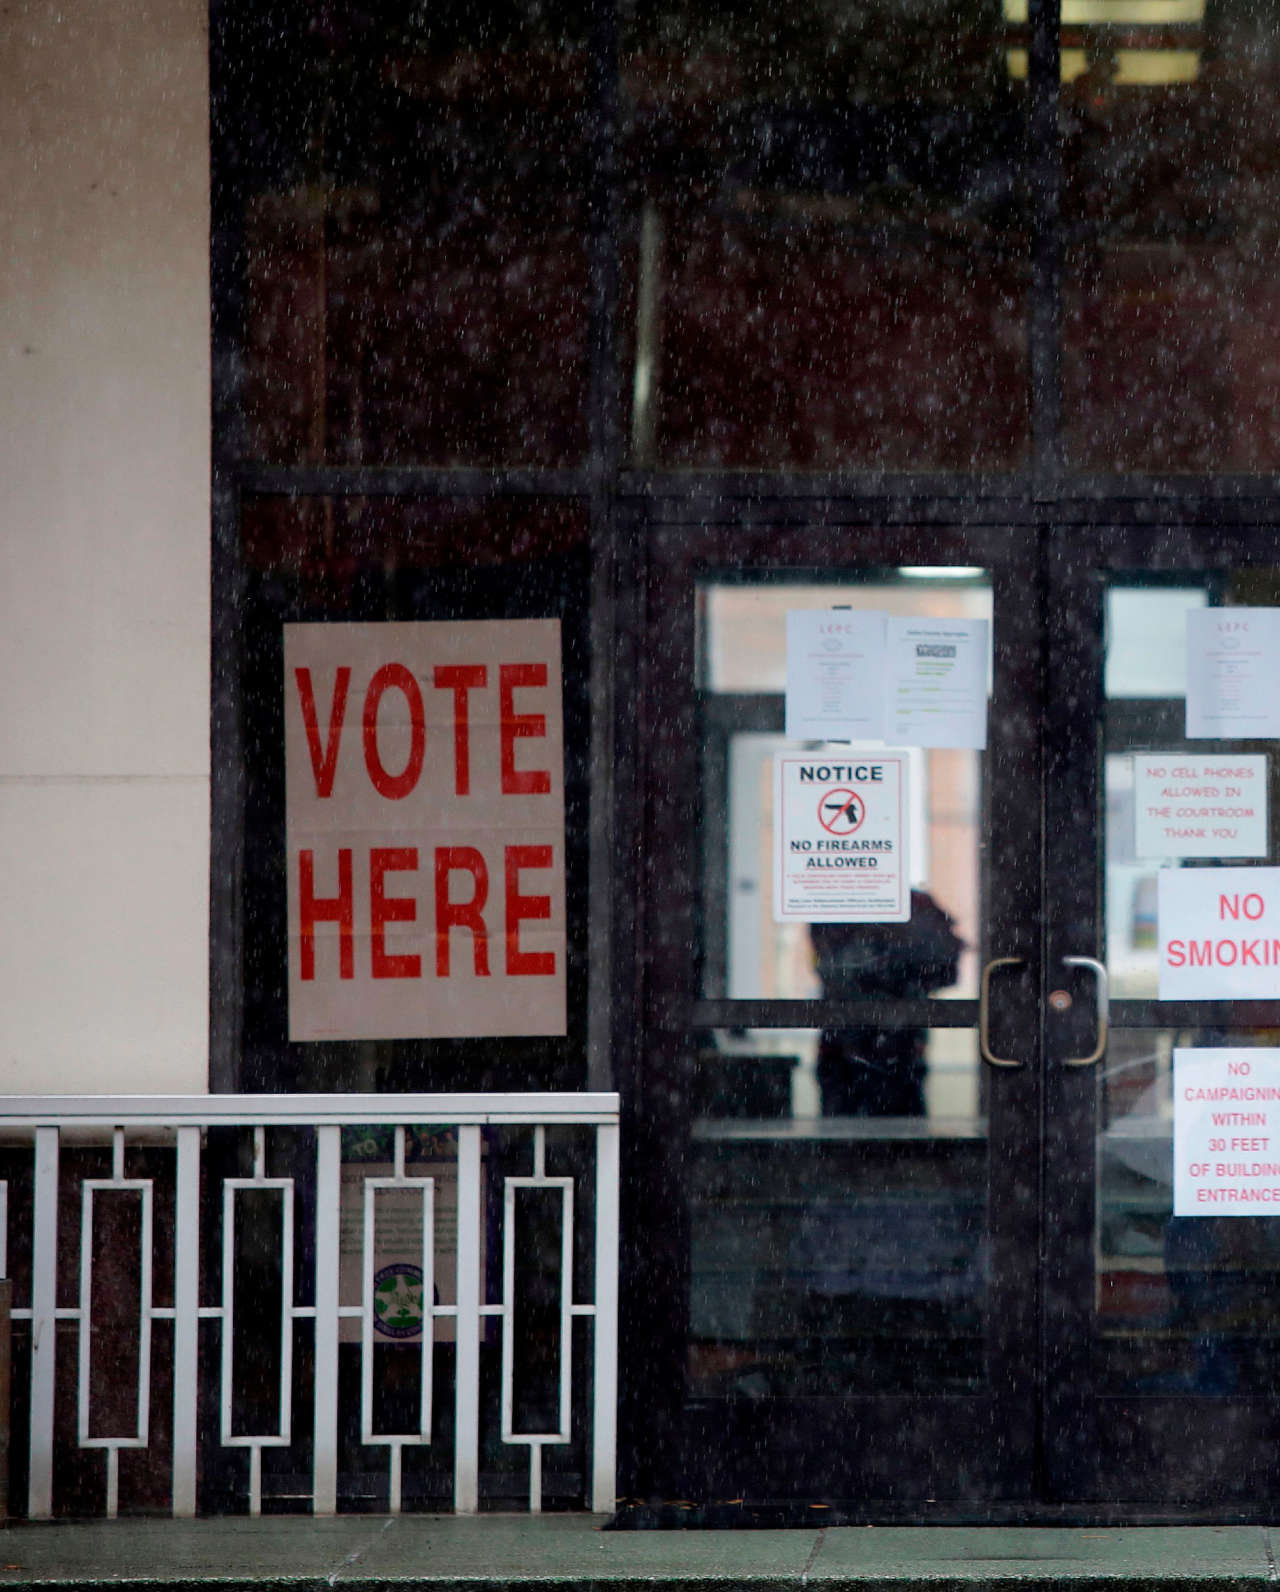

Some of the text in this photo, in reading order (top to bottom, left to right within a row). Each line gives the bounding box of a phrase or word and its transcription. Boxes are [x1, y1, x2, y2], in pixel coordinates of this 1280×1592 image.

[294, 663, 550, 800] VOTE
[799, 766, 883, 782] NOTICE
[1145, 767, 1255, 779] NO CELL PHONES
[1160, 786, 1243, 798] ALLOWED IN
[1147, 807, 1255, 818] THE COURTROOM
[1164, 827, 1237, 840] THANK YOU
[790, 839, 893, 851] NO FIREARMS
[806, 856, 878, 868] ALLOWED
[299, 845, 555, 980] HERE
[1219, 893, 1265, 921] NO
[1227, 1061, 1251, 1076] NO
[1211, 1111, 1267, 1126] WITHIN
[1207, 1136, 1270, 1153] 30 FEET
[1189, 1162, 1210, 1178] OF
[1196, 1187, 1280, 1203] ENTRANCE
